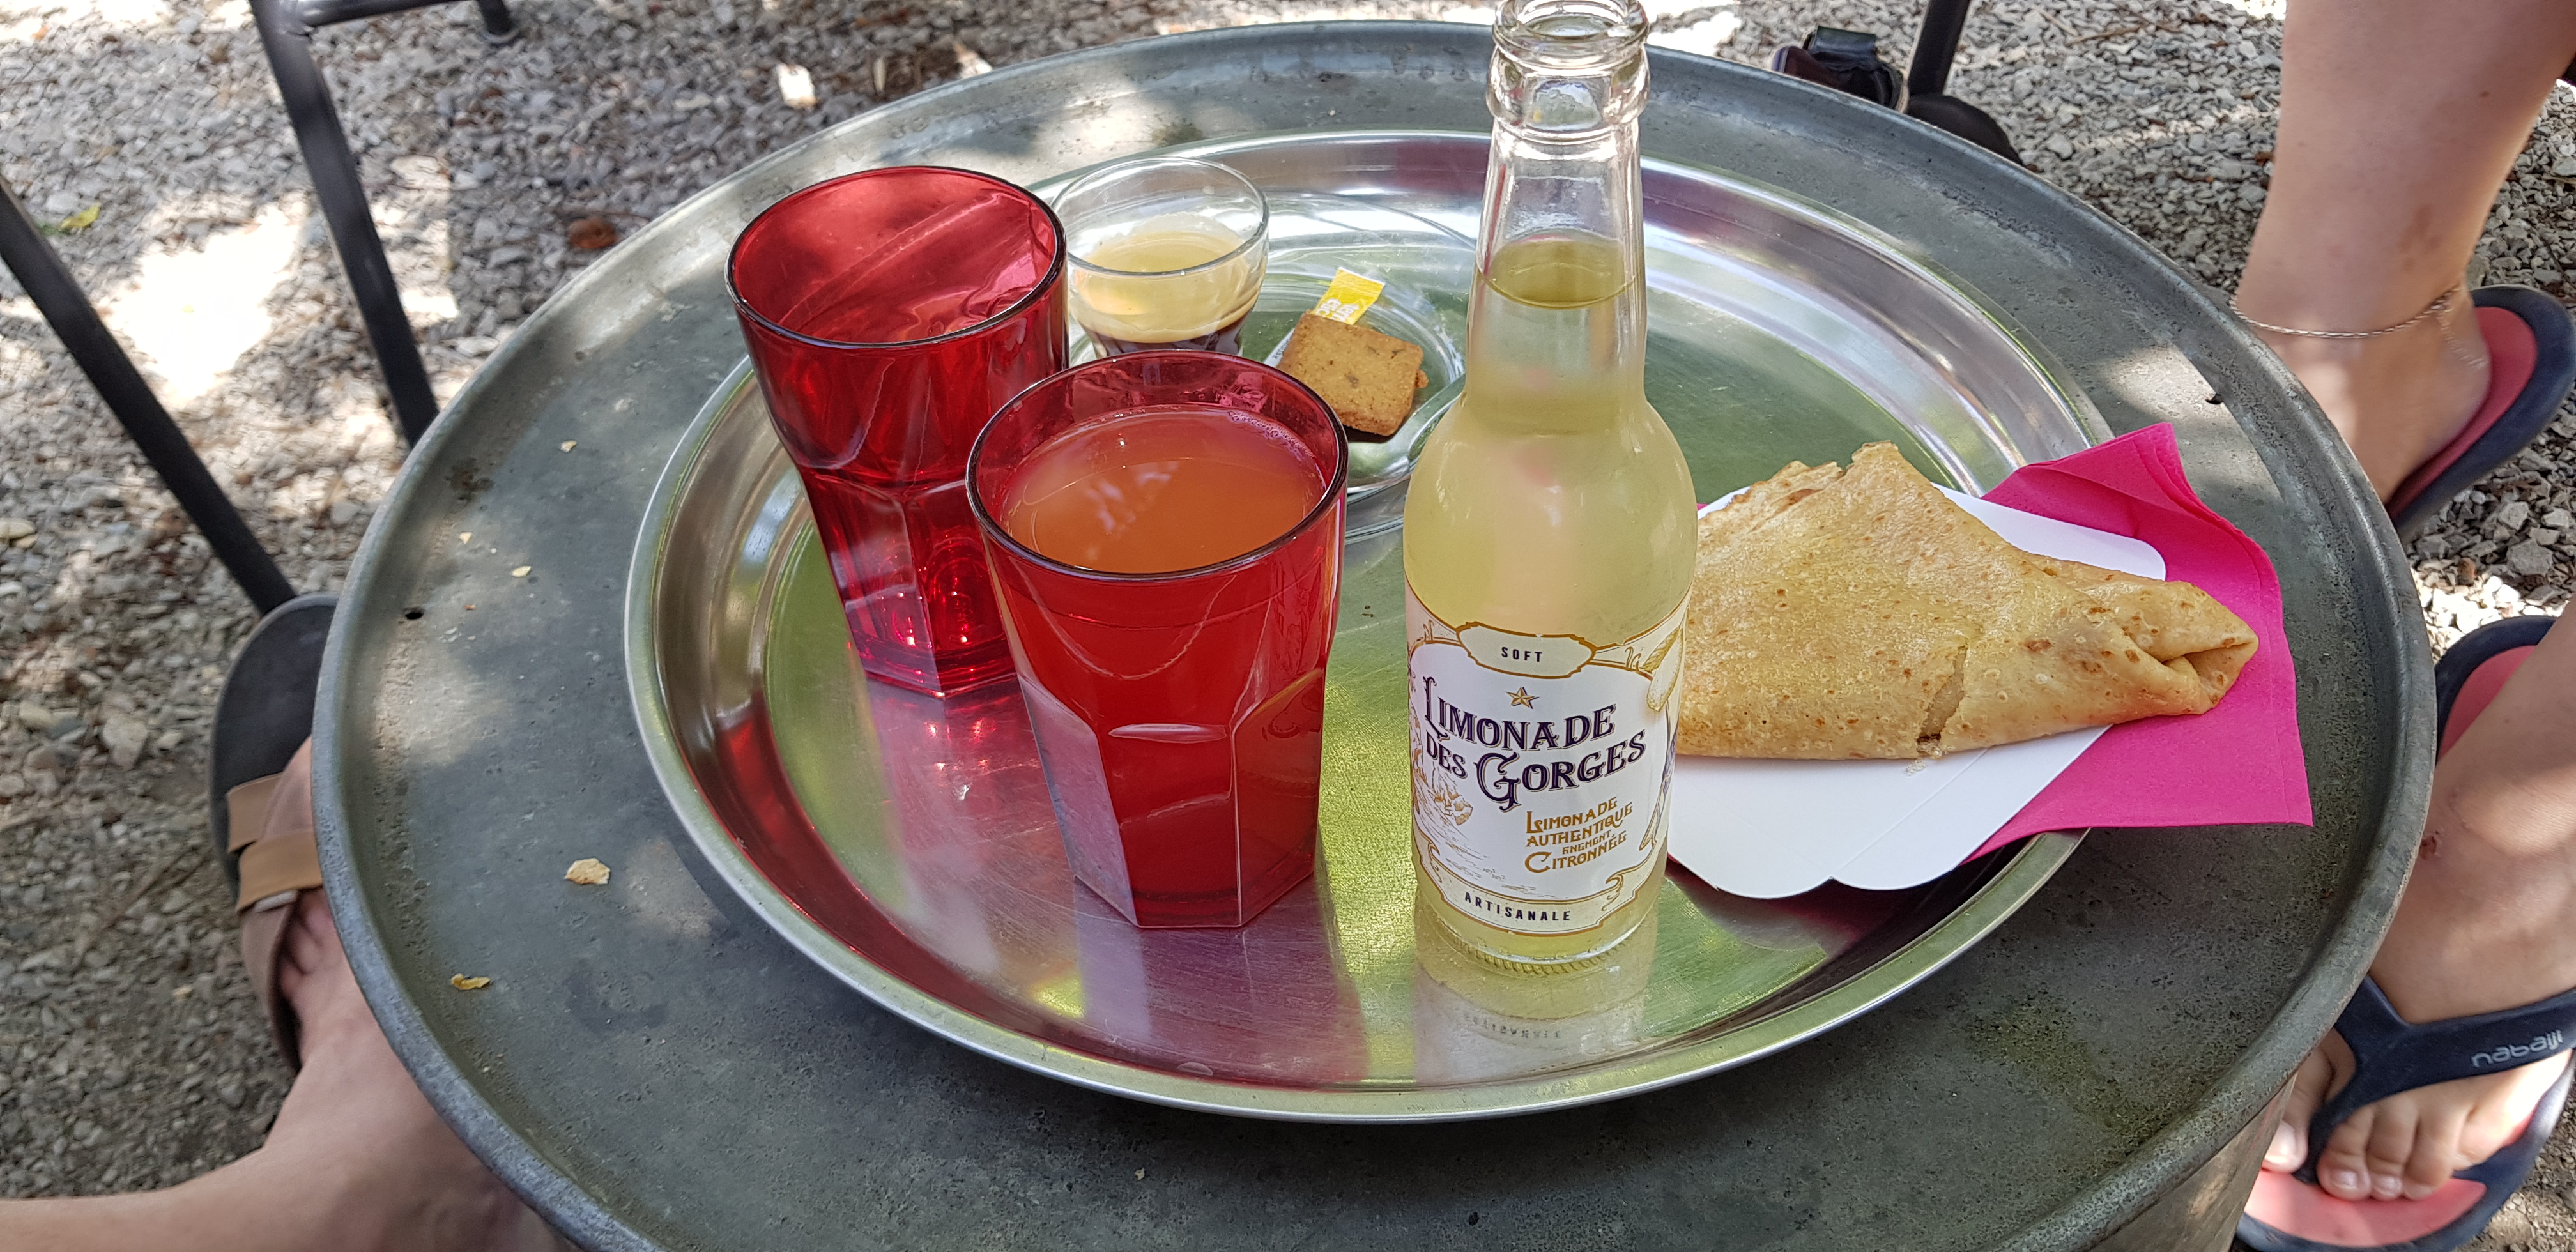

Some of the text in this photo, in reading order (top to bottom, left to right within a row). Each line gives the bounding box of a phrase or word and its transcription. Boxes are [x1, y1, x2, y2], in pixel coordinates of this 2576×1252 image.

[1501, 646, 1543, 662] SOFT
[1422, 676, 1617, 752] LIMONADE
[1425, 729, 1646, 812] DES GORGES
[1525, 801, 1634, 847] AUTHENTIQUE
[1526, 796, 1618, 834] LIMONADE
[1524, 830, 1627, 873] CITRONNÉE
[1464, 892, 1571, 921] ARTISANALE
[2471, 1028, 2563, 1067] nabaiji
